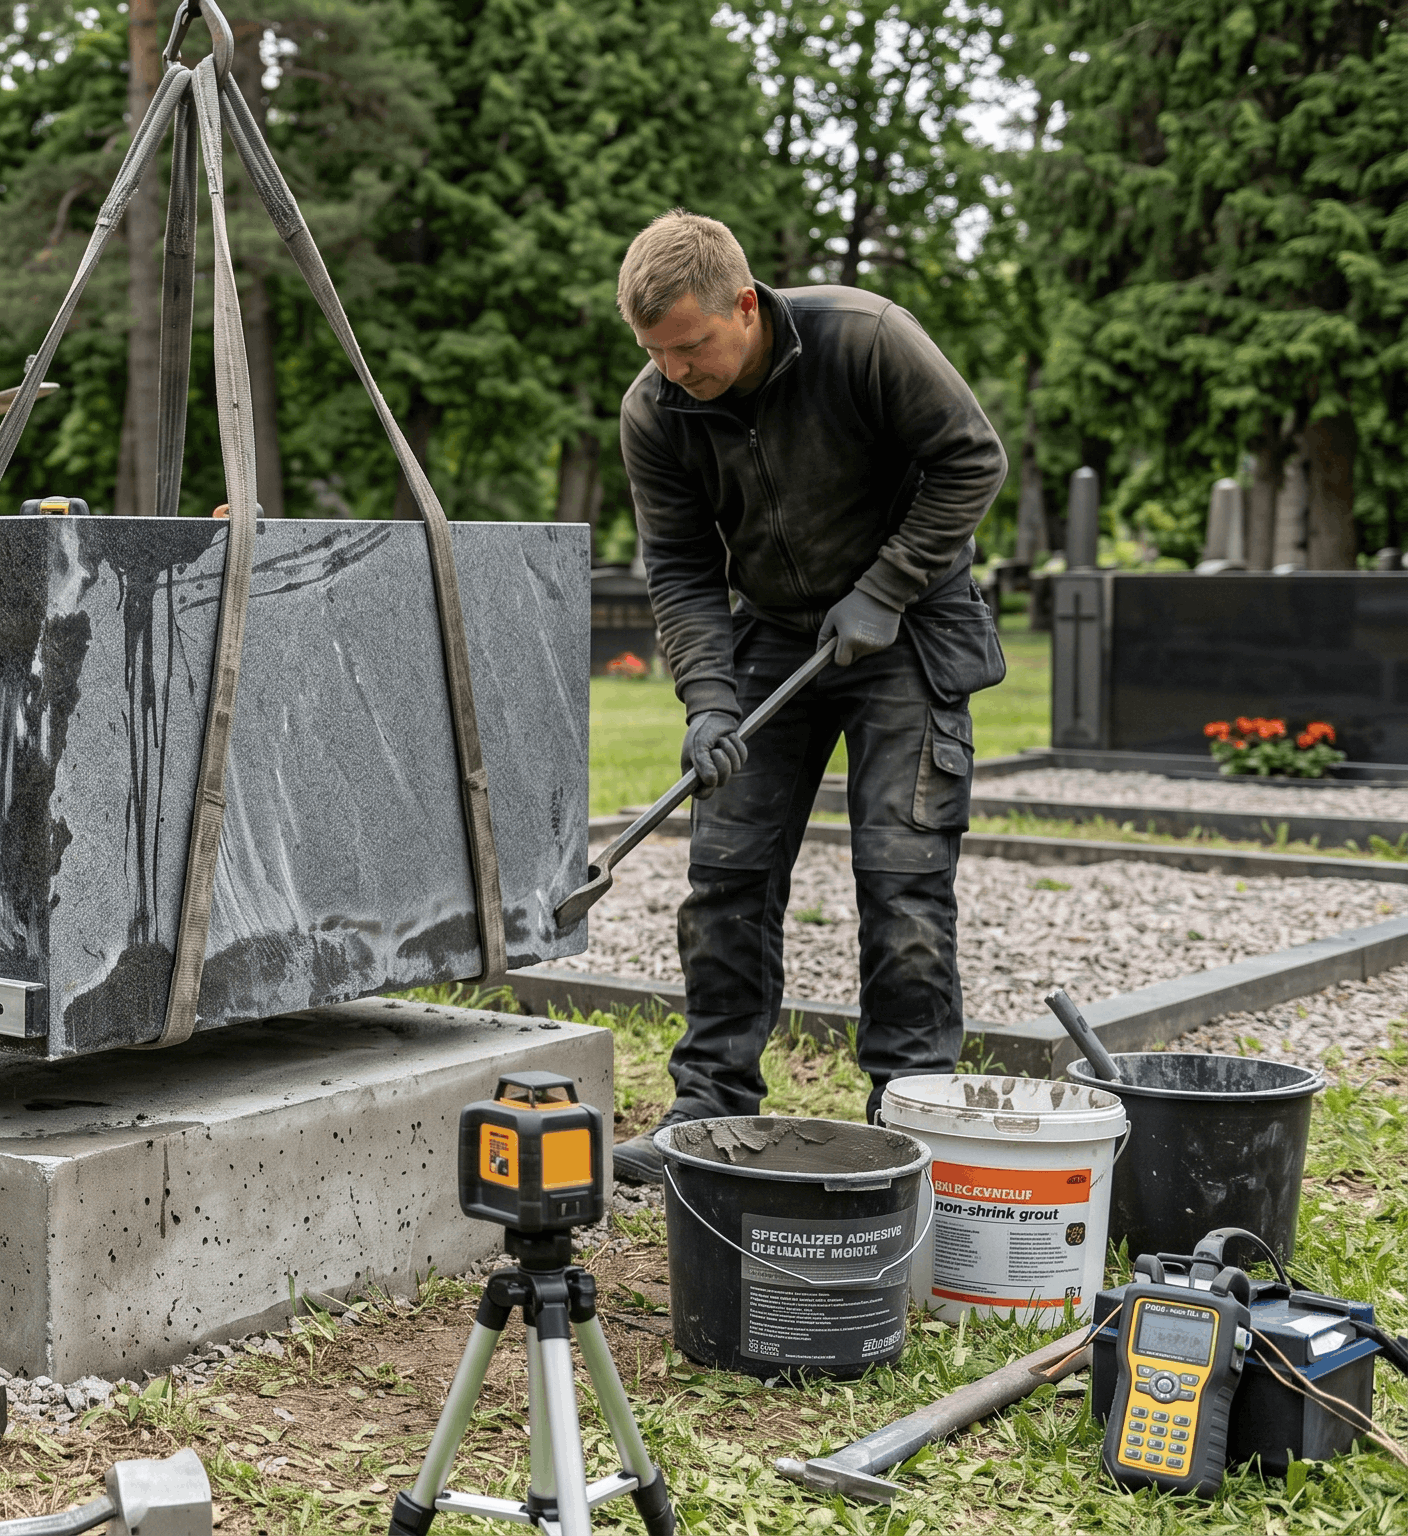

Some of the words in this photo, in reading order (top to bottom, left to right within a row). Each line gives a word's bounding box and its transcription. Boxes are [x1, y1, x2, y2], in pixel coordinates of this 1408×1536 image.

[935, 1201, 1016, 1220] non-shrink
[1019, 1208, 1059, 1222] grout
[751, 1229, 843, 1245] SPECIALIZED
